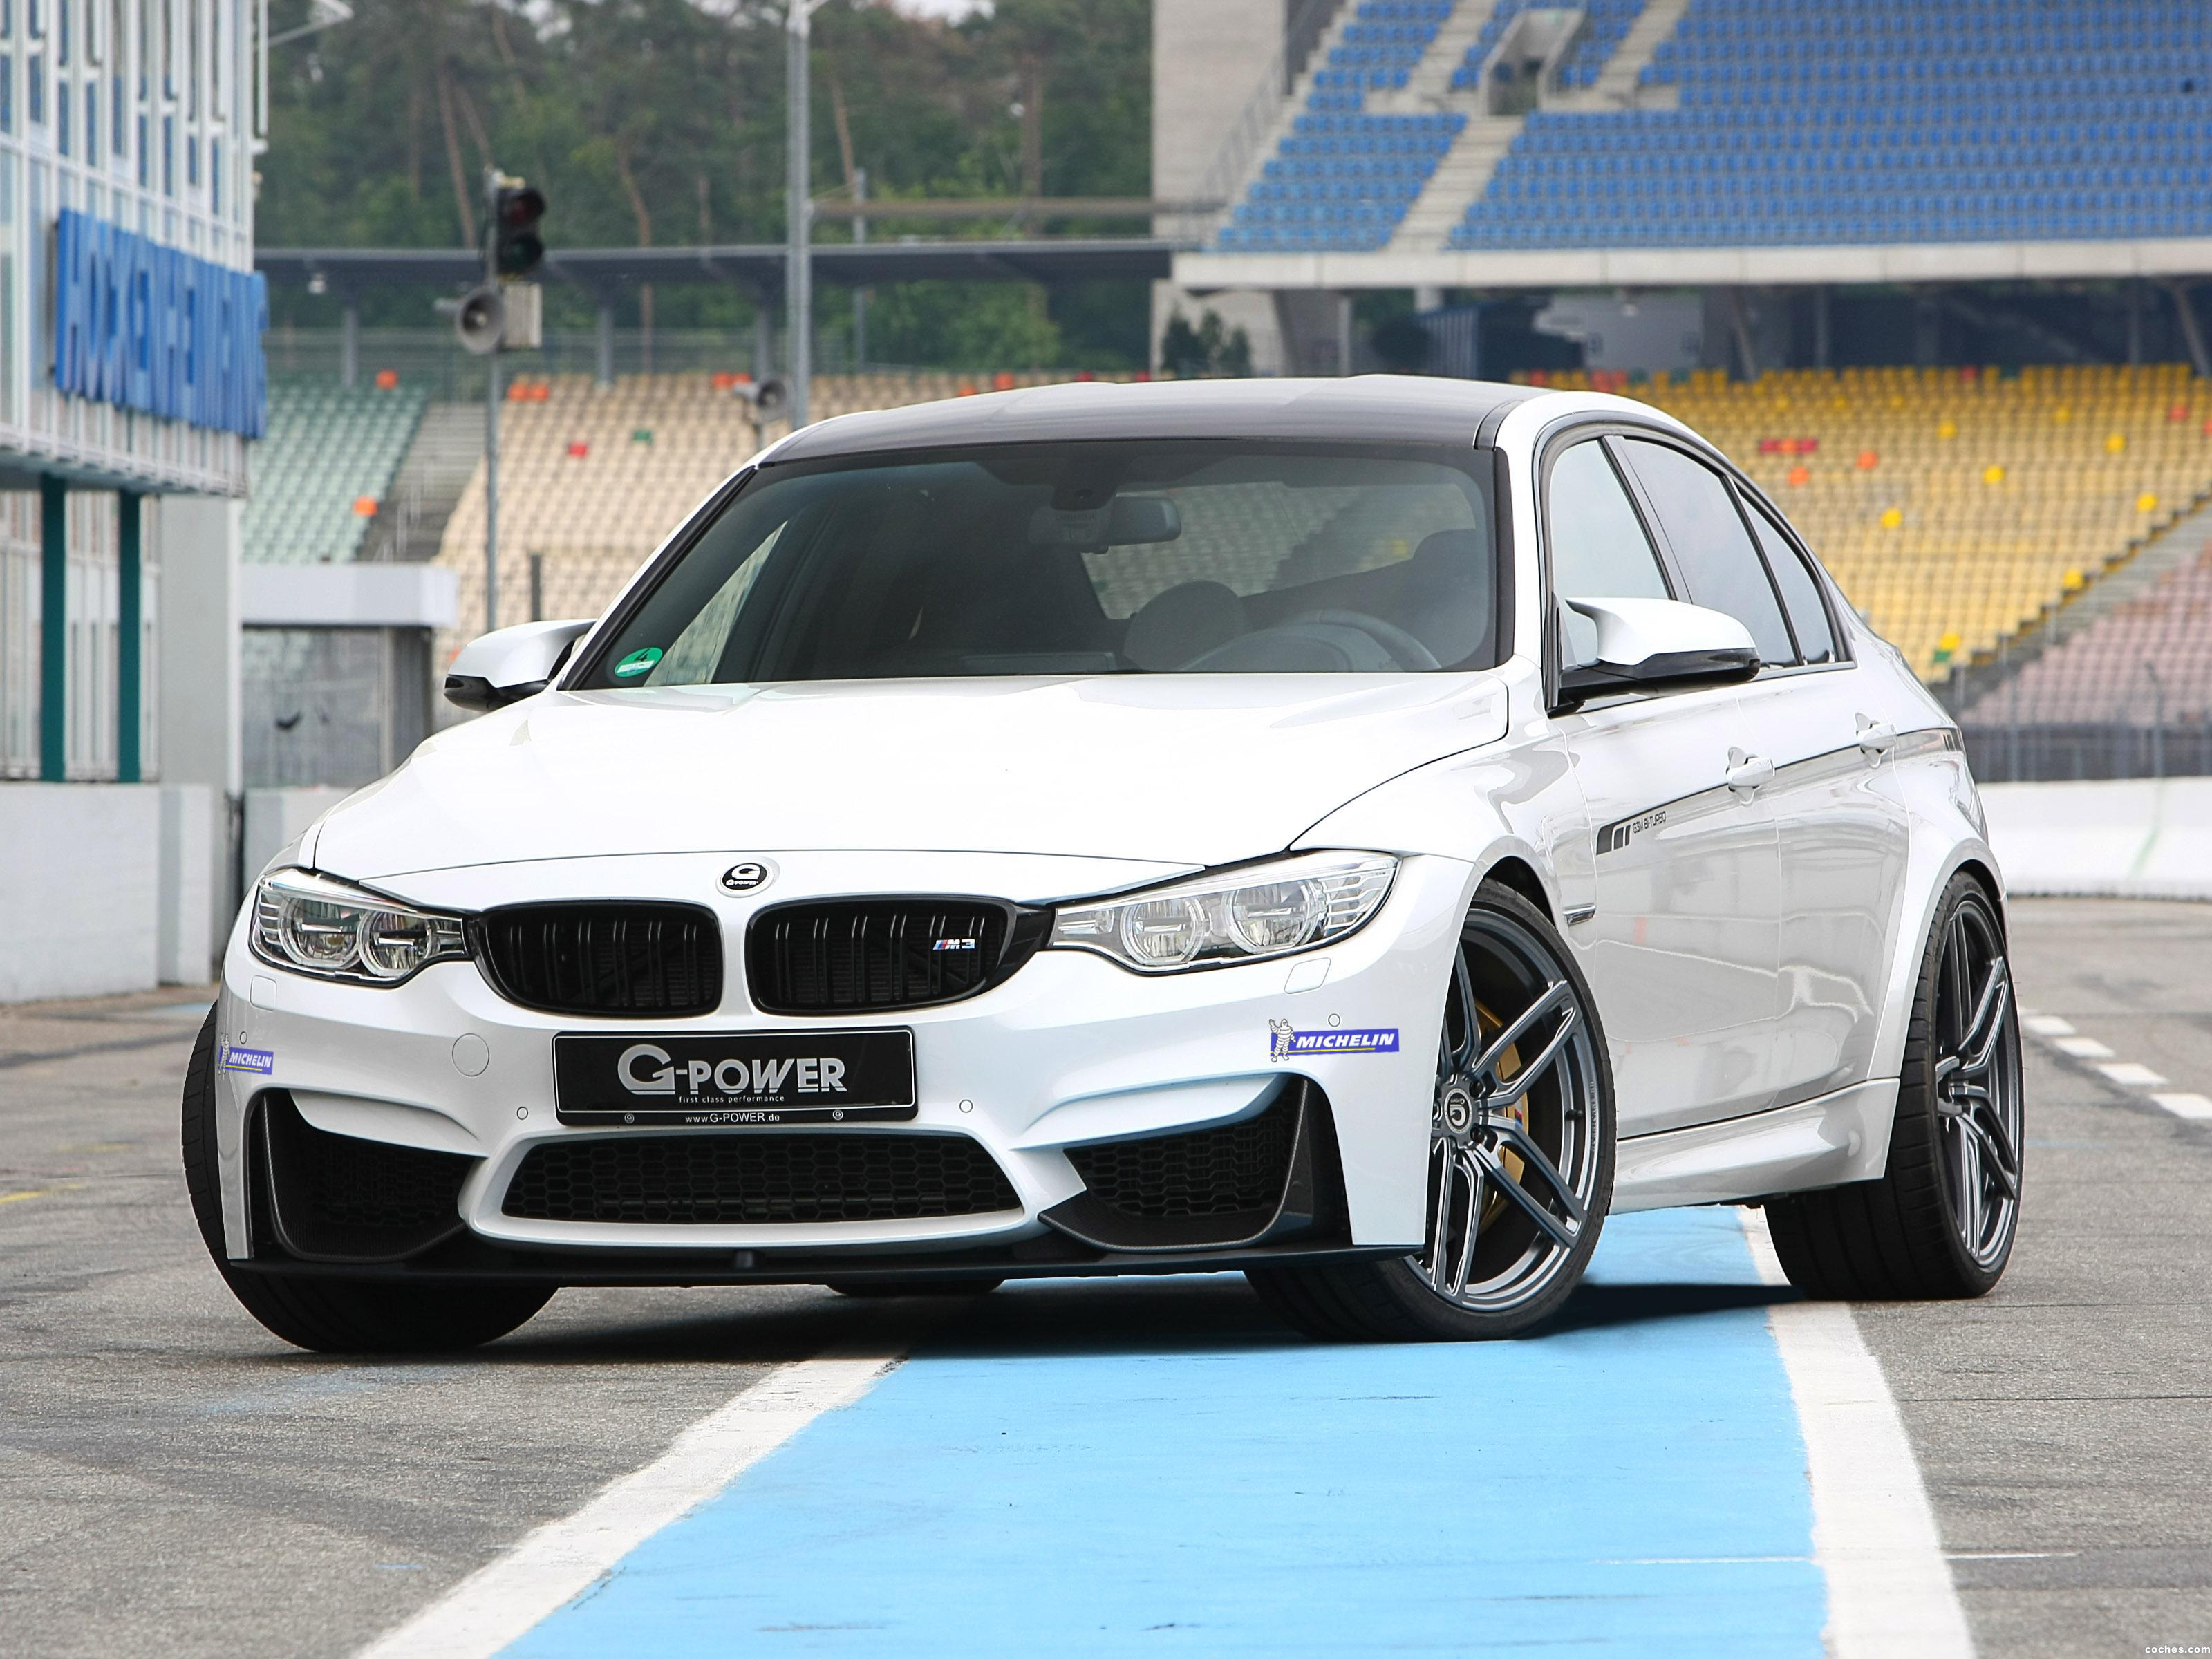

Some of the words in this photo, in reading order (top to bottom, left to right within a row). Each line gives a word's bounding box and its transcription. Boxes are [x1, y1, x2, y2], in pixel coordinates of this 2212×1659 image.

[942, 939, 975, 950] M3
[1296, 1033, 1394, 1049] MICHELIN
[229, 1052, 272, 1068] MICHELIN
[617, 1044, 847, 1095] G-POWER
[728, 1095, 785, 1104] performance
[685, 1112, 780, 1123] www.G-POWER.de
